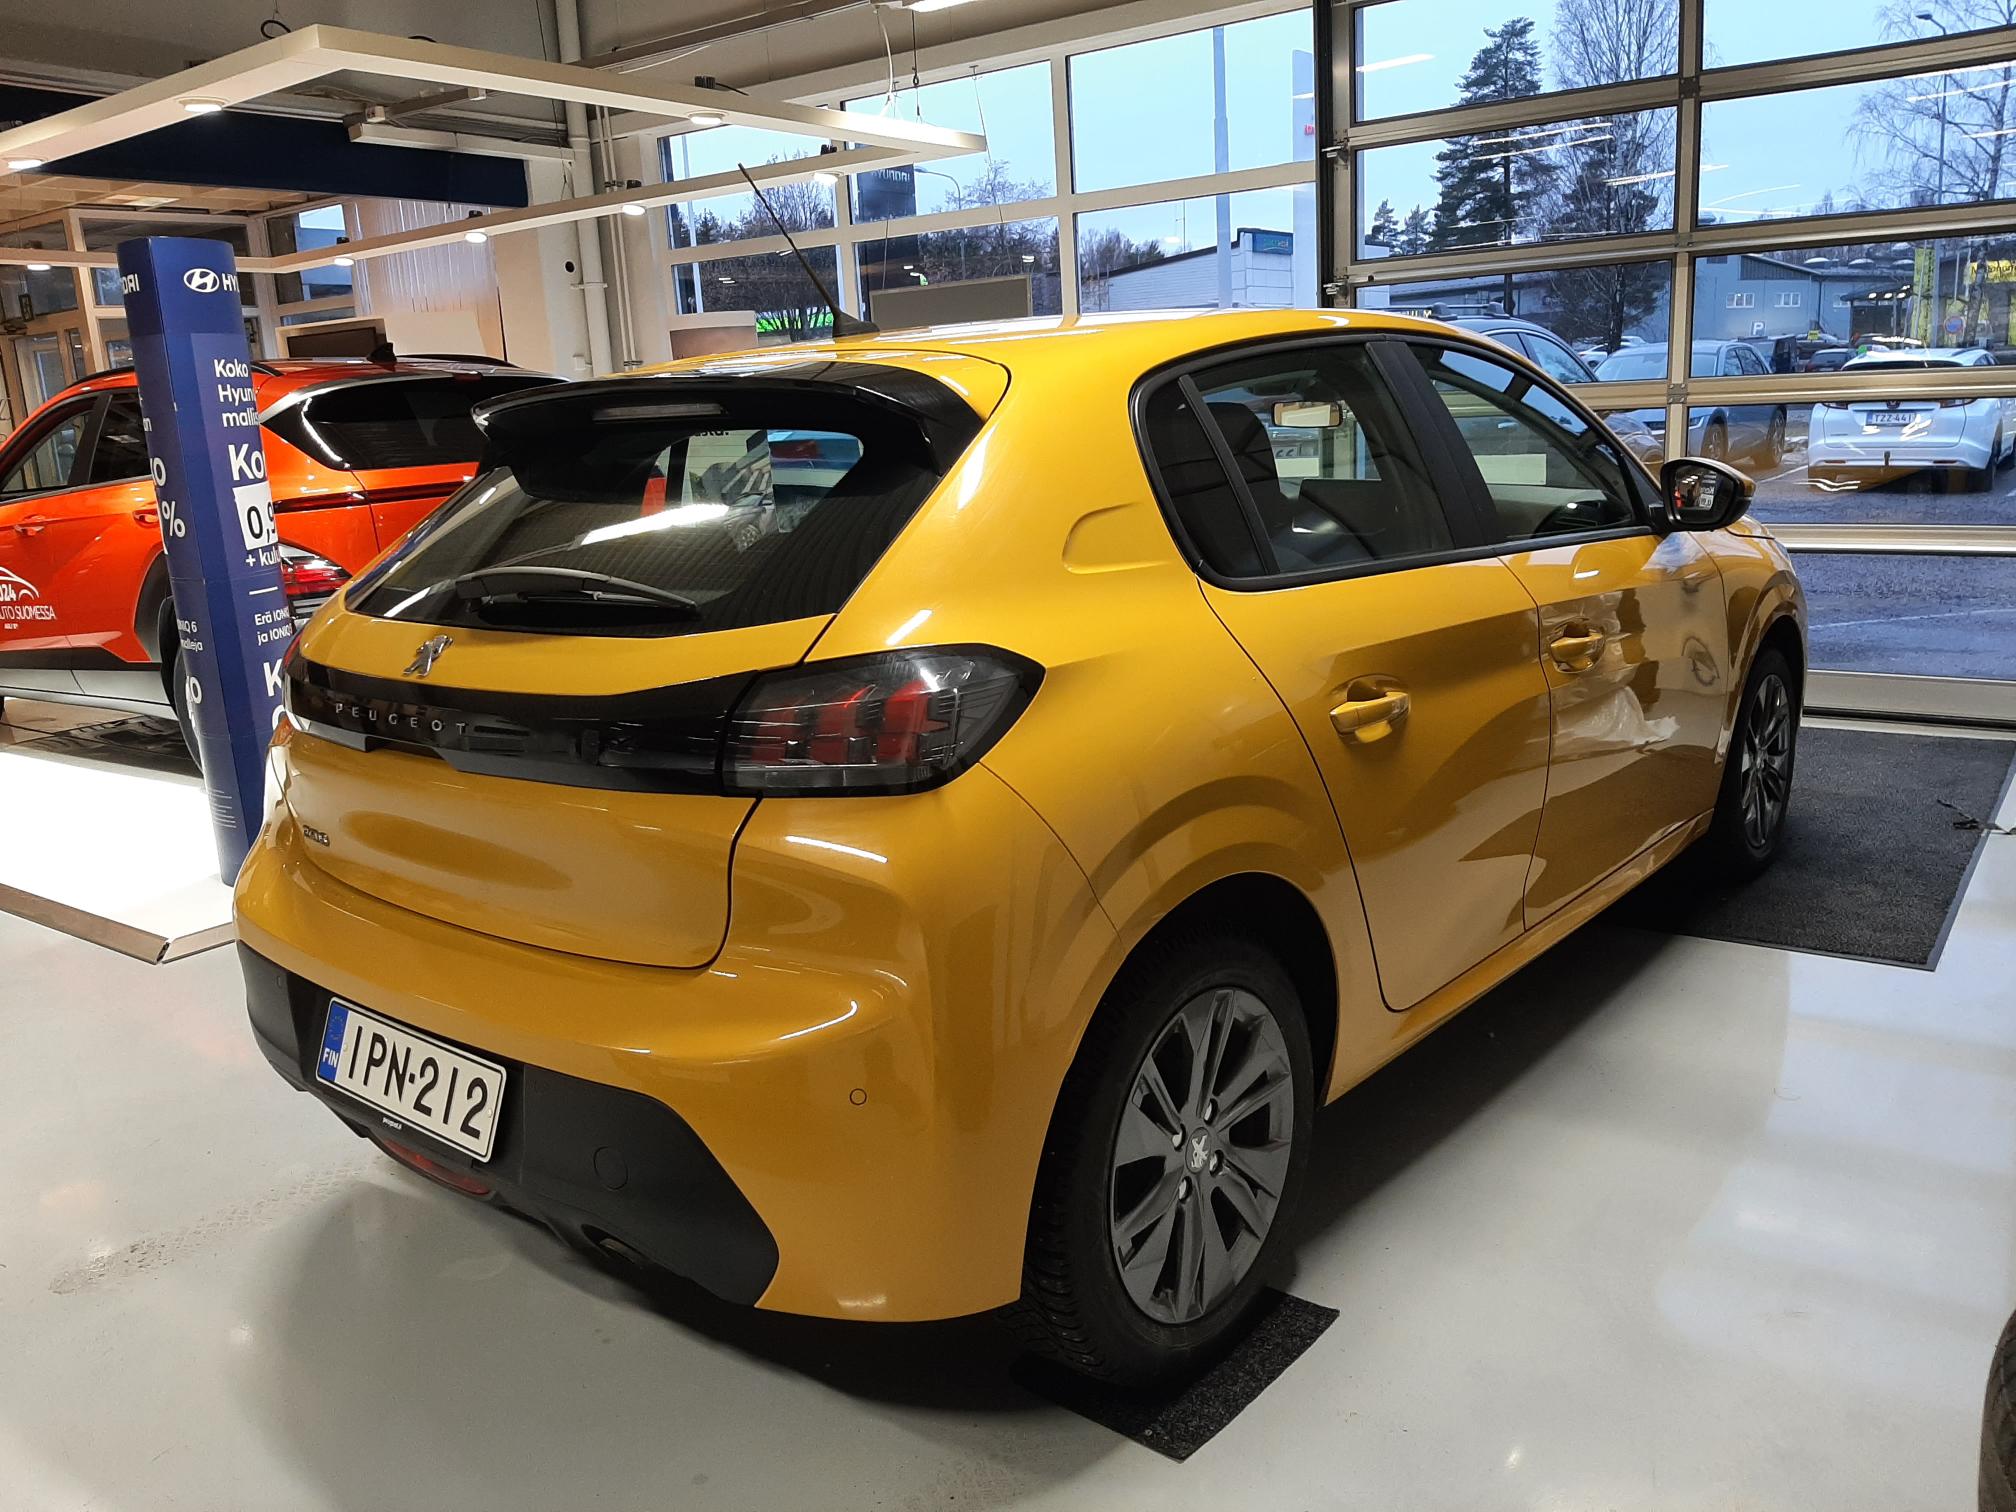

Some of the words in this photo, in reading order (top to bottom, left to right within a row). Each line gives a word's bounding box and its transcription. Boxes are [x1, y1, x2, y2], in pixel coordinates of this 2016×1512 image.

[1752, 322, 1764, 336] P
[213, 358, 249, 378] Koko
[227, 443, 267, 481] Ko
[254, 610, 273, 626] Erä
[257, 631, 269, 646] ja
[335, 702, 466, 736] PEUGEOT
[322, 1047, 340, 1069] FIN
[348, 1025, 488, 1140] IPN-212
